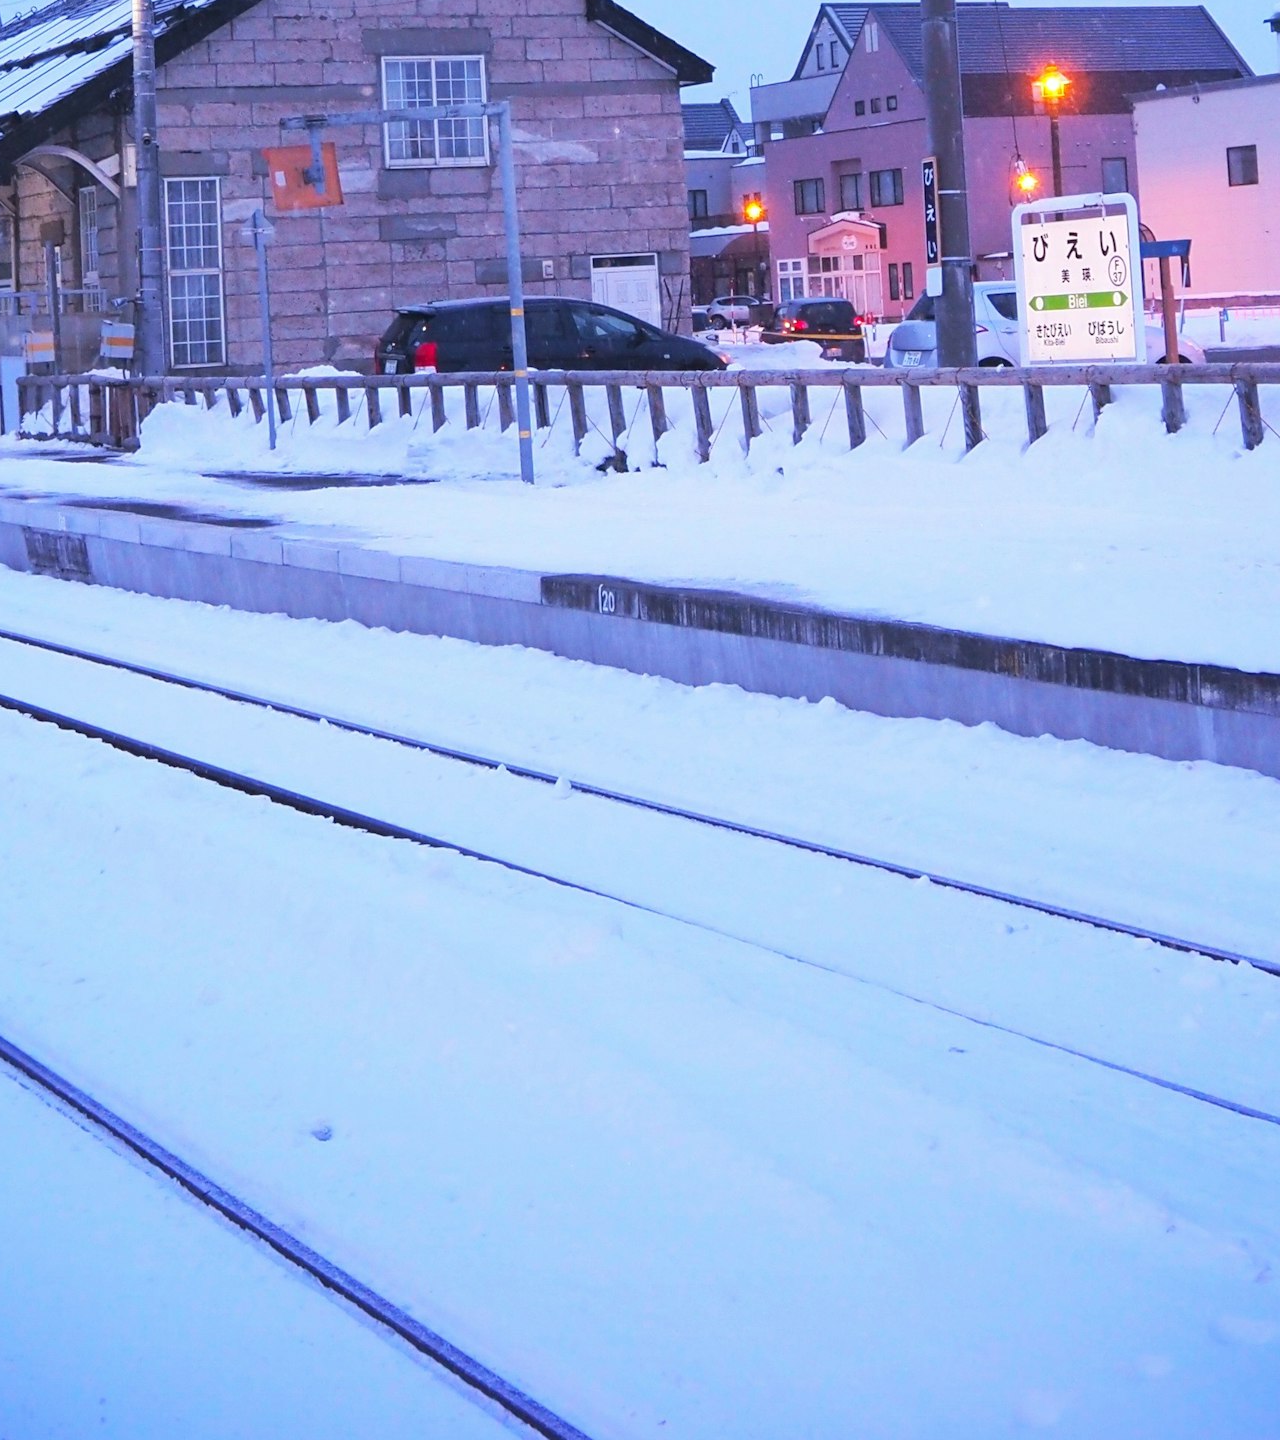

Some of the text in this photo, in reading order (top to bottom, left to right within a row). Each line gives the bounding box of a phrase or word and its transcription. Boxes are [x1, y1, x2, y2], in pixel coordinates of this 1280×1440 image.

[1032, 231, 1117, 262] びえい
[1114, 260, 1120, 271] F
[1112, 271, 1123, 283] 37
[1068, 293, 1088, 309] Biei
[1036, 323, 1072, 338] きたびえい
[1088, 320, 1125, 336] びばうし
[1095, 336, 1119, 345] Bibaushi
